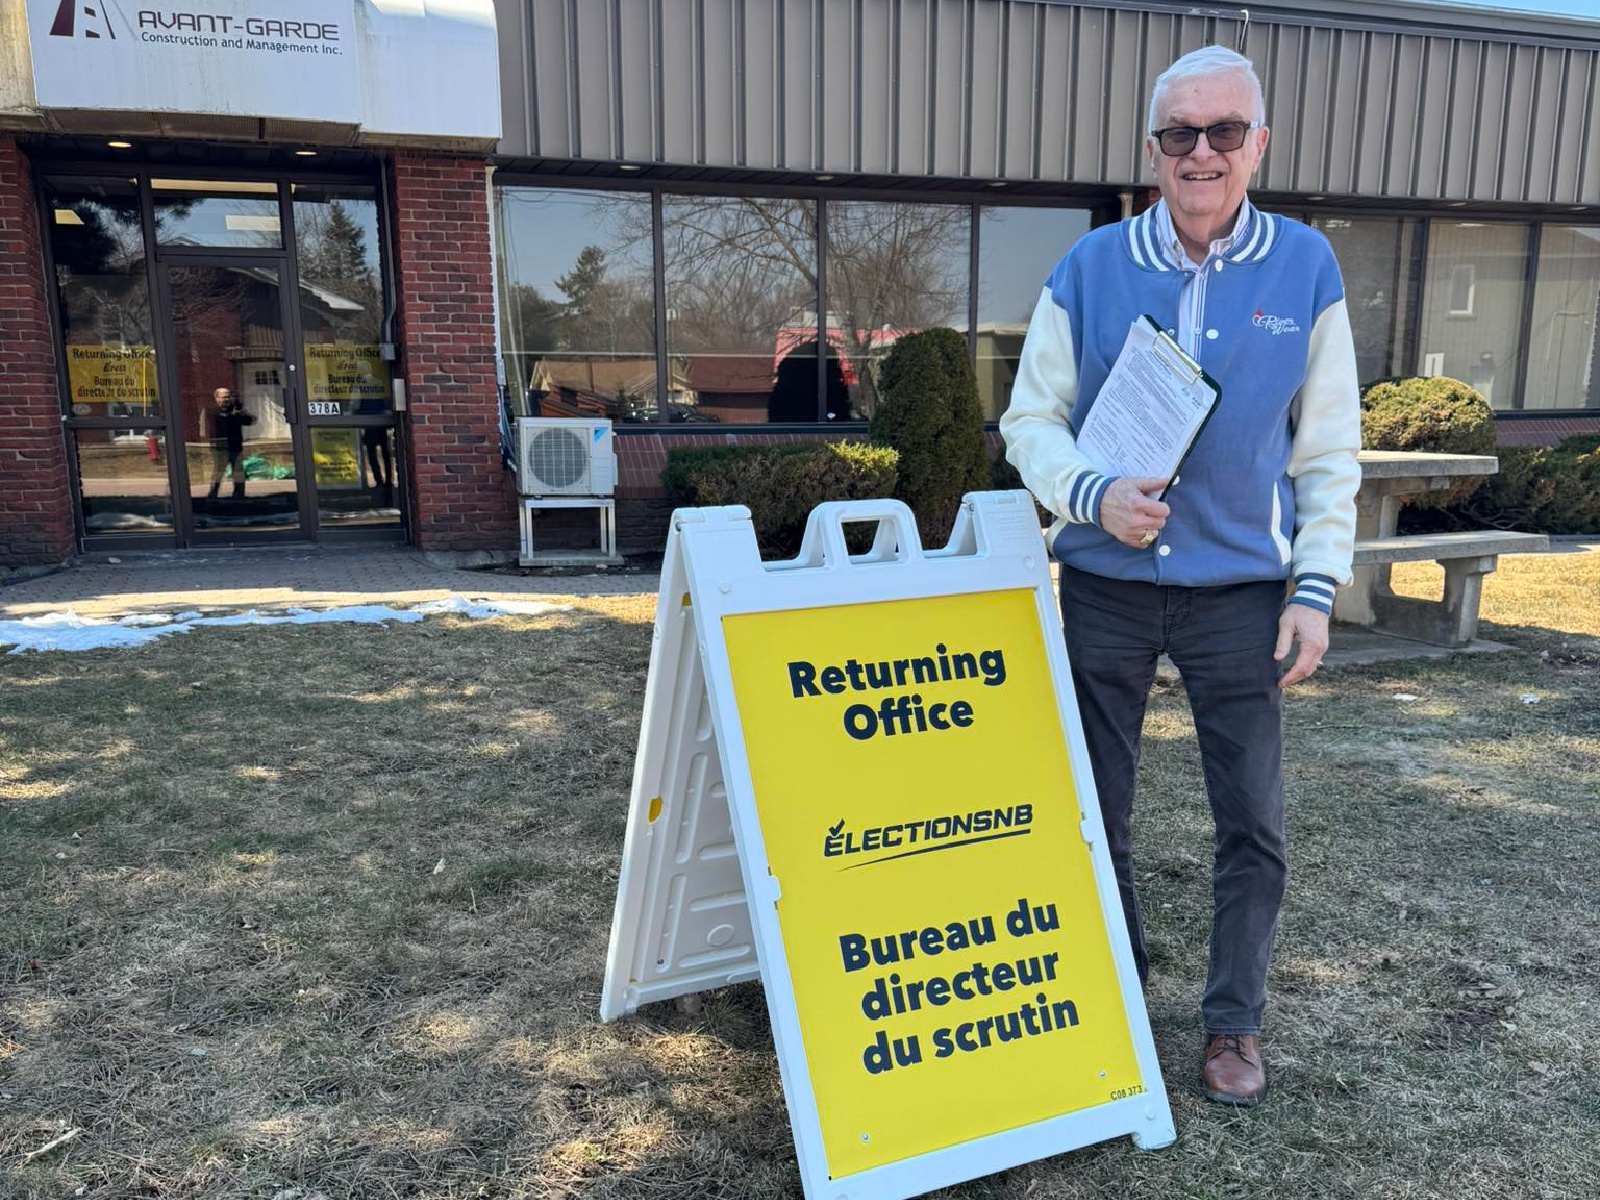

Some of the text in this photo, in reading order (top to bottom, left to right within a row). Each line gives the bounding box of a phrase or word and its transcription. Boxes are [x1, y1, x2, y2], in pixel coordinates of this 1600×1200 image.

[138, 10, 340, 41] AVANT-GARDE
[141, 31, 343, 55] Construction and Management Inc.
[73, 347, 122, 361] Returning
[309, 403, 339, 414] 378A
[787, 643, 1007, 699] Returning
[844, 693, 975, 741] Office
[839, 898, 1060, 973] Bureau du
[861, 952, 1059, 1021] directeur
[863, 992, 1080, 1075] du scrutin
